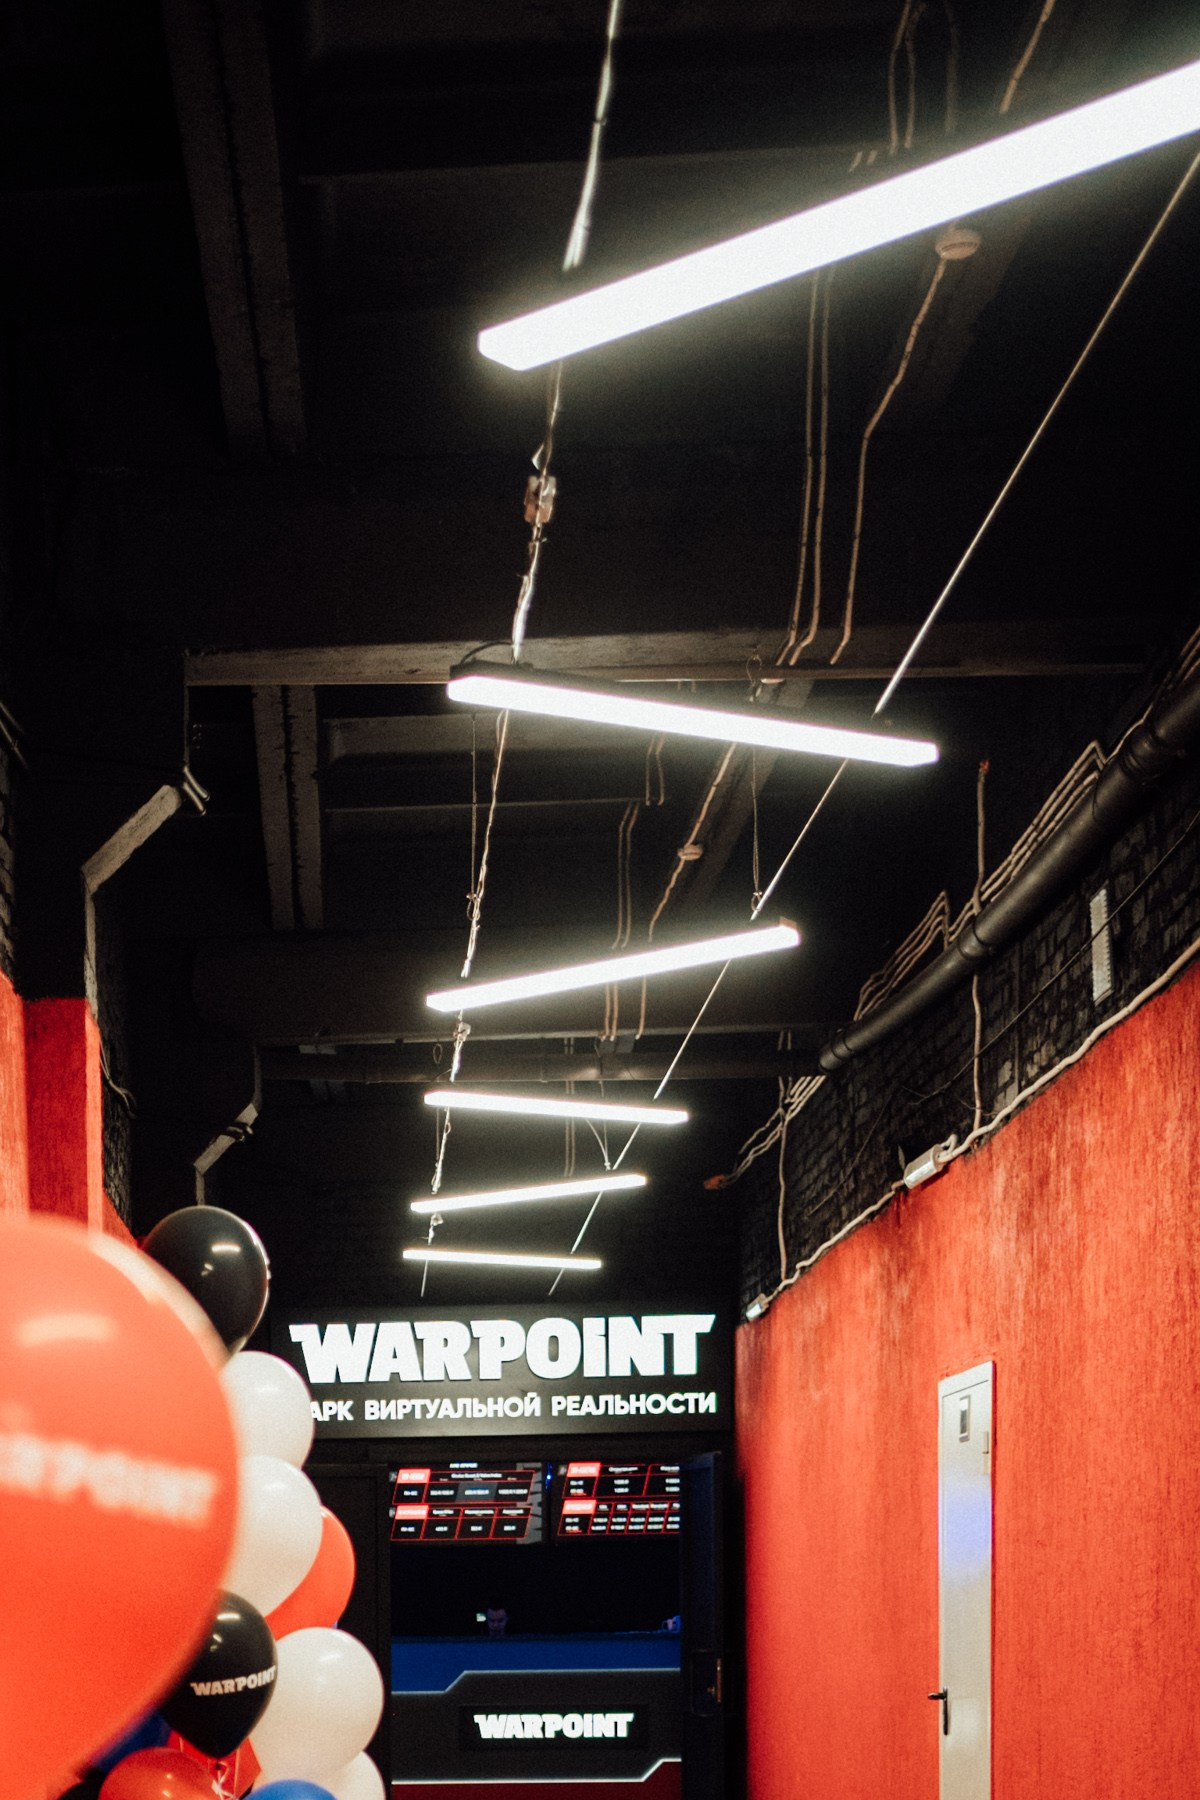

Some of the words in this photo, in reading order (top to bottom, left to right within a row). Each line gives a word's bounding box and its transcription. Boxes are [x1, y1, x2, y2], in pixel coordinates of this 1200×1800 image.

[288, 1314, 716, 1384] WARPOINT
[310, 1400, 354, 1421] АРК
[364, 1392, 540, 1421] ВИРТУАЛЬНОЙ
[551, 1392, 717, 1417] РЕАЛЬНОСТИ
[190, 1665, 276, 1697] WARPOINT
[473, 1712, 634, 1739] WARPOINT
